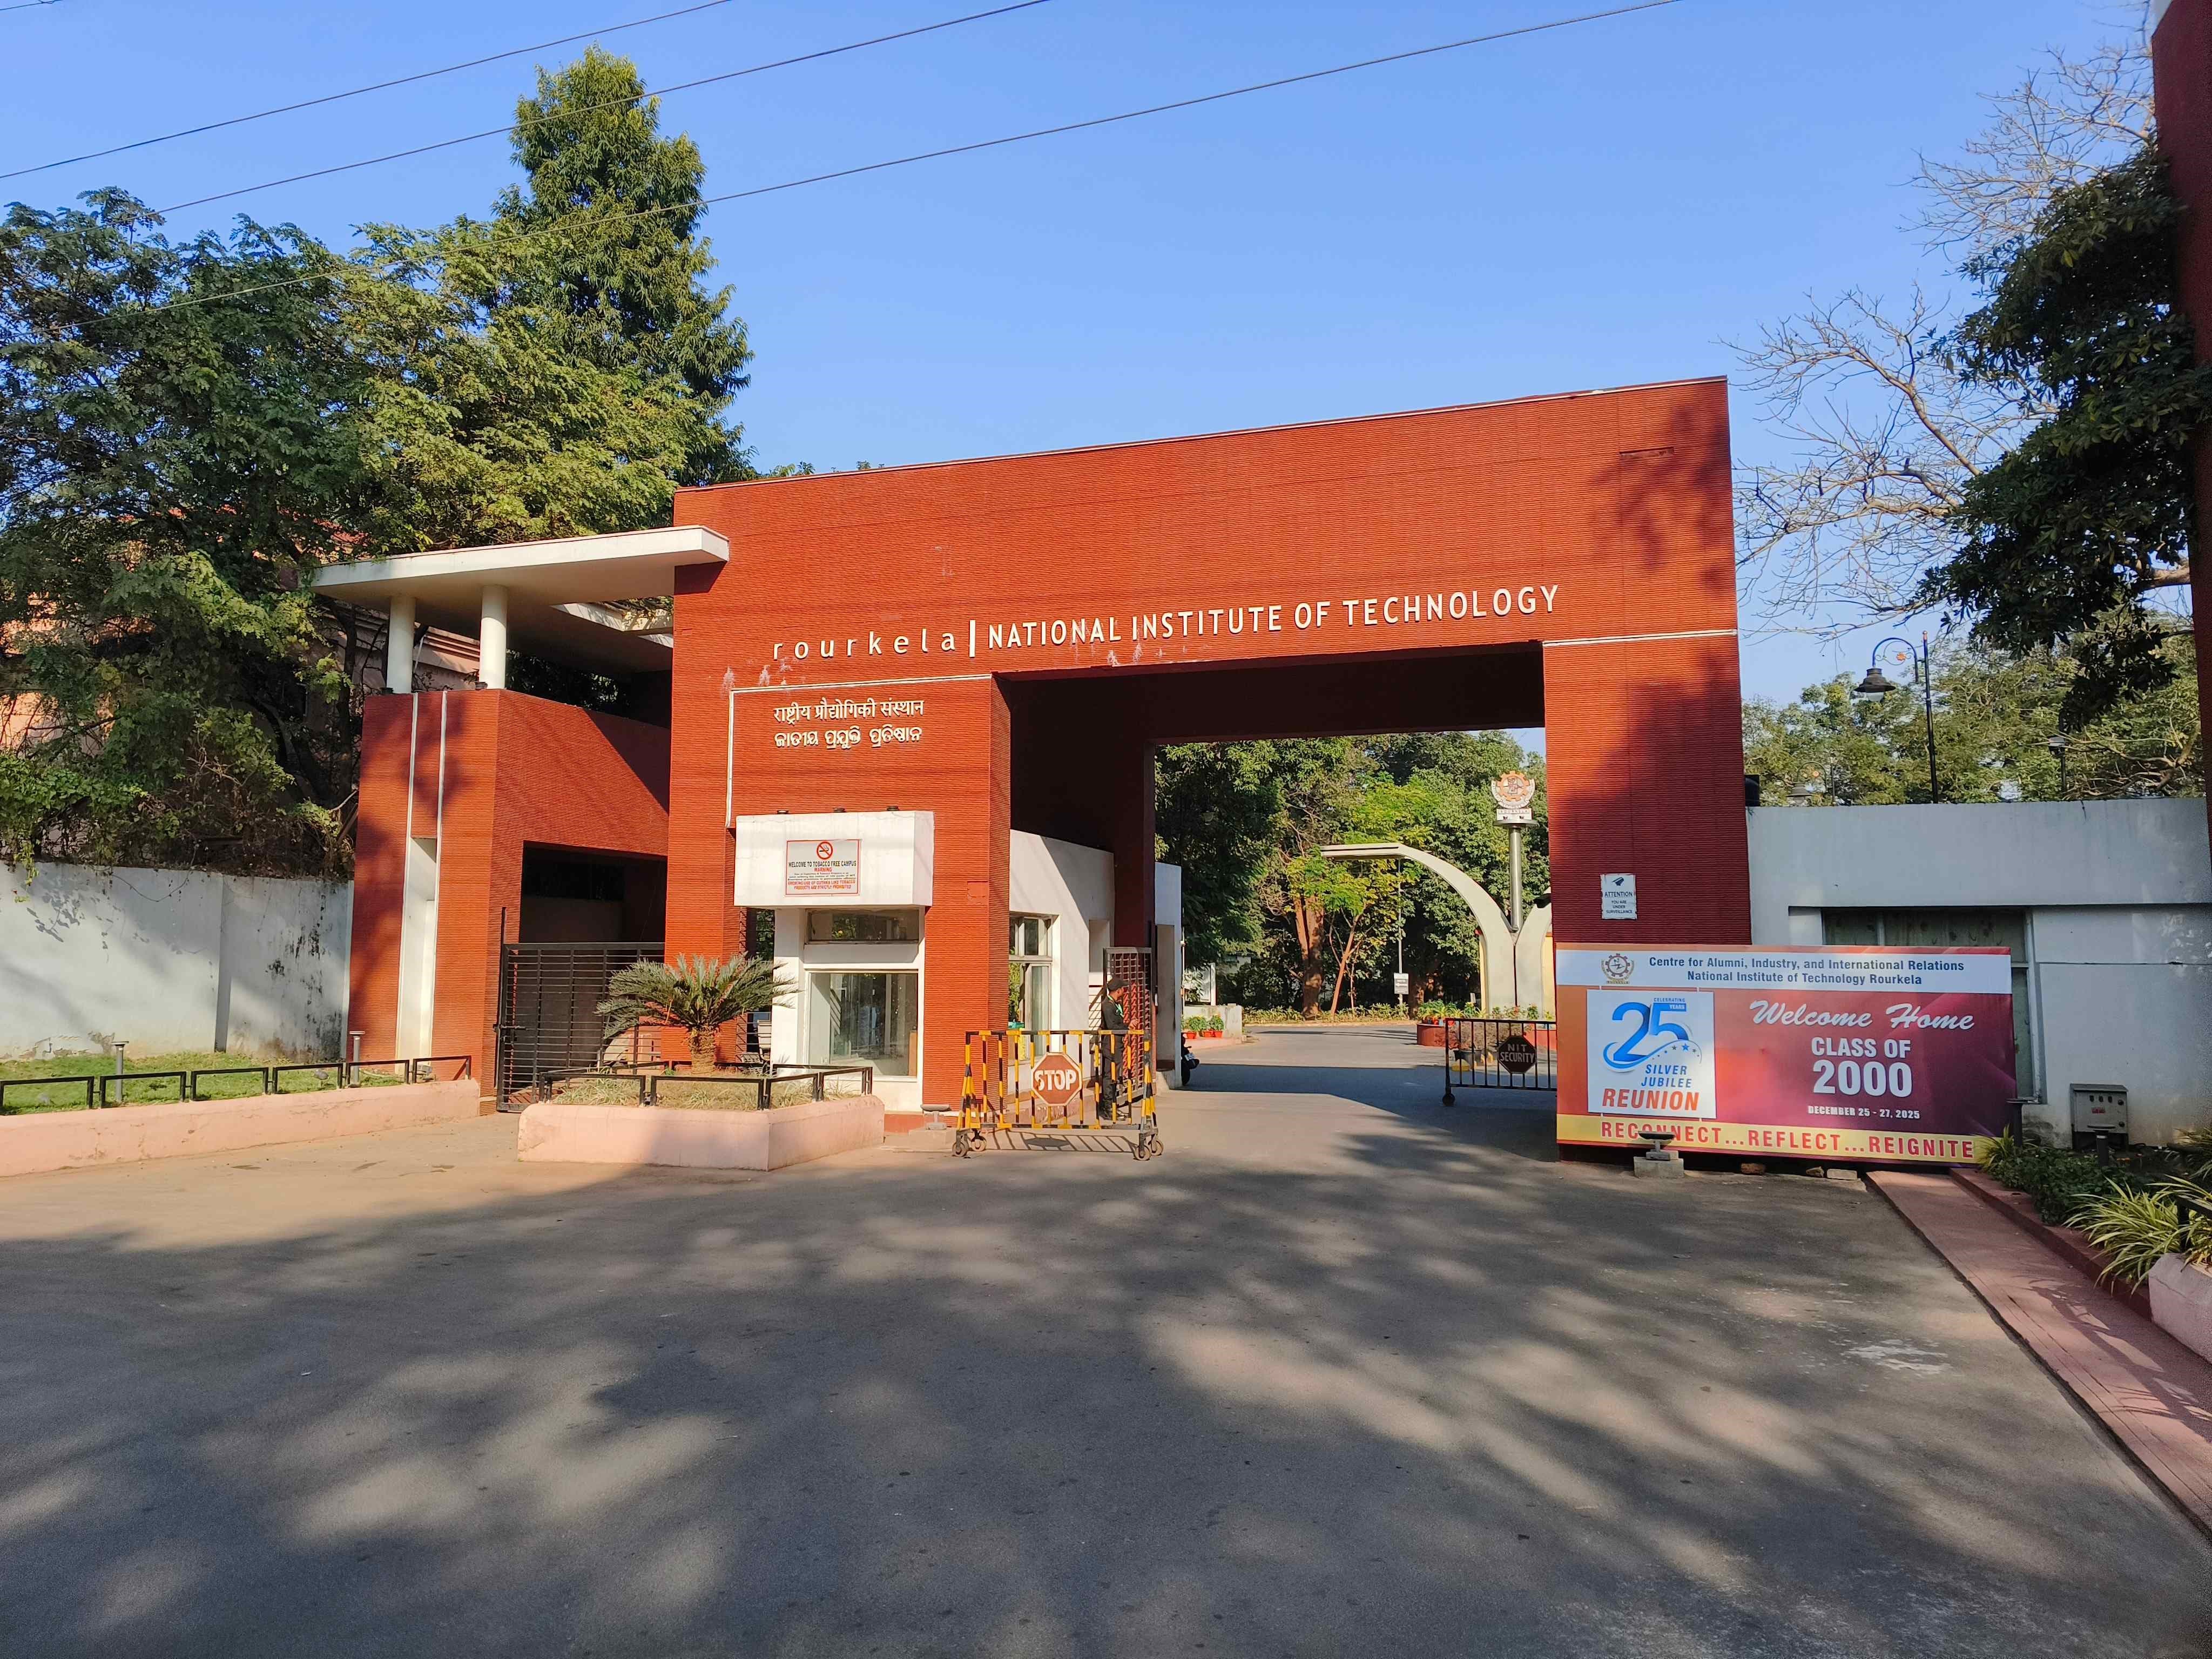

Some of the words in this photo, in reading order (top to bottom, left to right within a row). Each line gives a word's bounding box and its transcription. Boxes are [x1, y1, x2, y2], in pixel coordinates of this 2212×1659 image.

[773, 628, 956, 660] rourkela
[988, 616, 1122, 649] NATIONAL
[1131, 605, 1282, 641] INSTITUTE
[1294, 601, 1331, 630] OF
[1342, 584, 1559, 627] TECHNOLOGY
[773, 702, 812, 725] राष्ट्रीय
[814, 697, 877, 720] प्रौद्योगिकी
[880, 697, 925, 717] संस्थान
[1649, 957, 1685, 967] Centre
[1689, 957, 1704, 967] for
[1707, 958, 1748, 969] Alumni,
[1751, 958, 1800, 970] Industry,
[1804, 959, 1824, 969] and
[1829, 959, 1904, 970] International
[1908, 960, 1965, 971] Relations
[1688, 970, 1733, 981] National
[1737, 972, 1784, 982] Institute
[1788, 973, 1798, 982] of
[1802, 973, 1865, 986] Technology
[1870, 974, 1922, 984] Rourkela
[1749, 1000, 1873, 1026] Welcome
[1885, 1003, 1975, 1030] Home
[1612, 1002, 1689, 1062] 25
[1500, 1051, 1535, 1063] SECURITY
[1507, 1043, 1527, 1051] NIT
[1811, 1036, 1877, 1057] CLASS
[1884, 1039, 1911, 1058] OF
[1034, 1069, 1077, 1091] STOP
[1645, 1064, 1688, 1075] SILVER
[1812, 1059, 1913, 1097] 2000
[1641, 1077, 1692, 1088] JUBILEE
[1602, 1088, 1700, 1111] REUNION
[1808, 1105, 1856, 1116] DECEMBER
[1858, 1108, 1871, 1117] 25
[1896, 1110, 1920, 1120] 2025
[1869, 1136, 1974, 1158] REIGNITE
